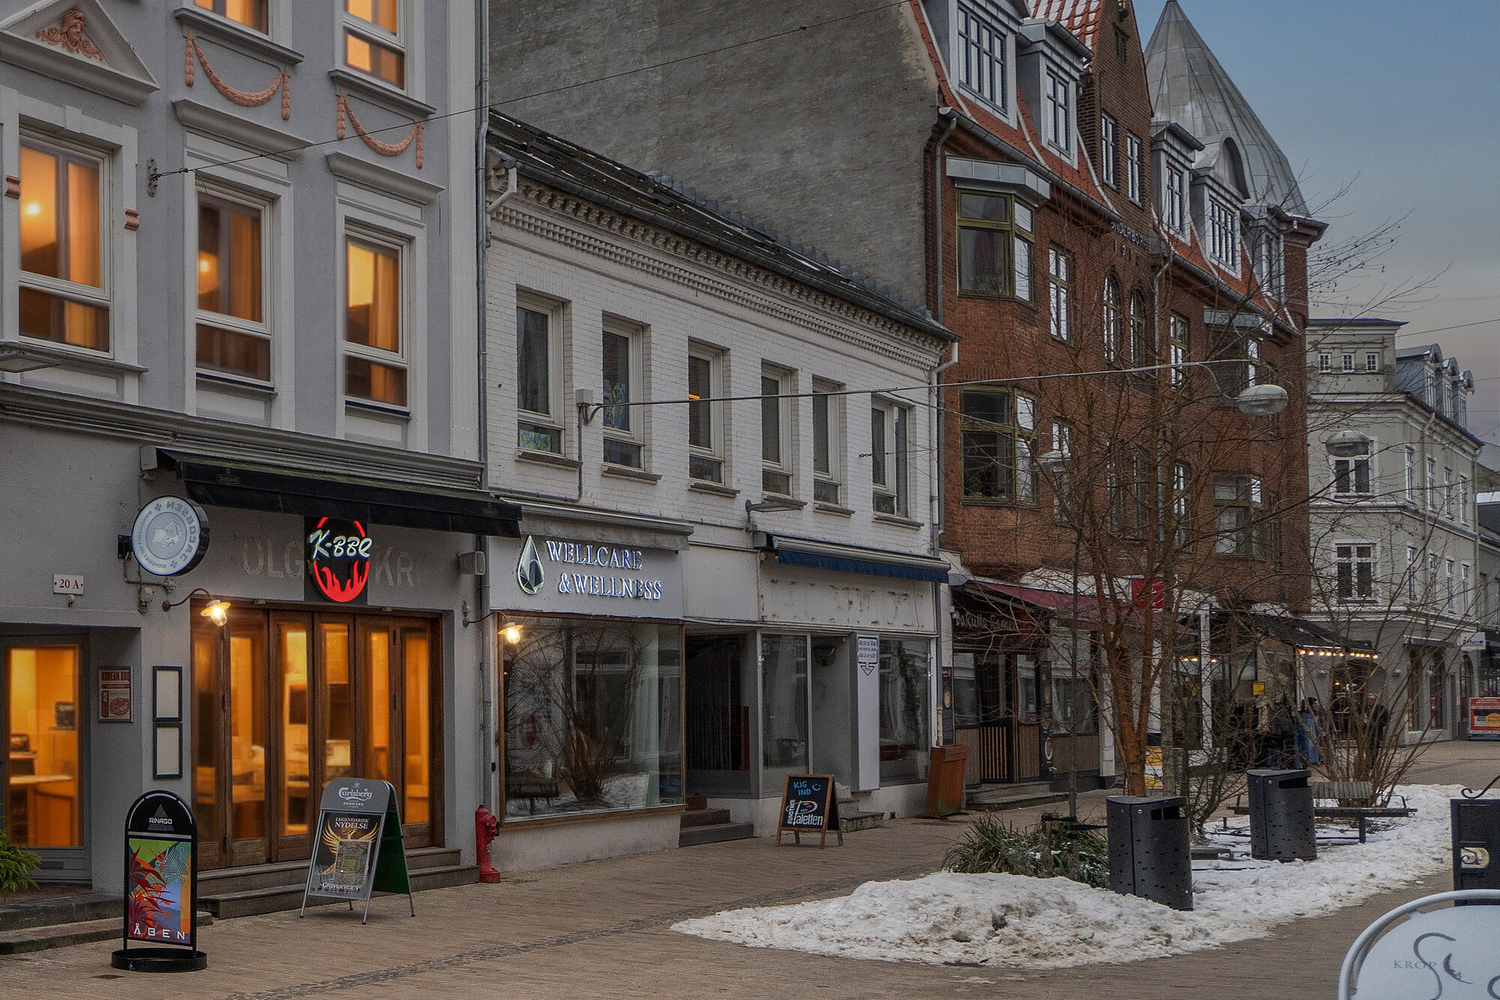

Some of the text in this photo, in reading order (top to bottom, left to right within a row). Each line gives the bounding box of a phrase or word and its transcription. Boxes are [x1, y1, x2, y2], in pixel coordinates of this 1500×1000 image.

[546, 540, 644, 570] WELLCARE
[59, 578, 80, 589] 20 A
[793, 780, 808, 789] KIG
[338, 786, 373, 801] Carlsberg
[798, 788, 812, 796] IND
[148, 817, 173, 825] RINAGO
[334, 822, 369, 830] NYDELSE
[133, 922, 185, 940] ÅBEN
